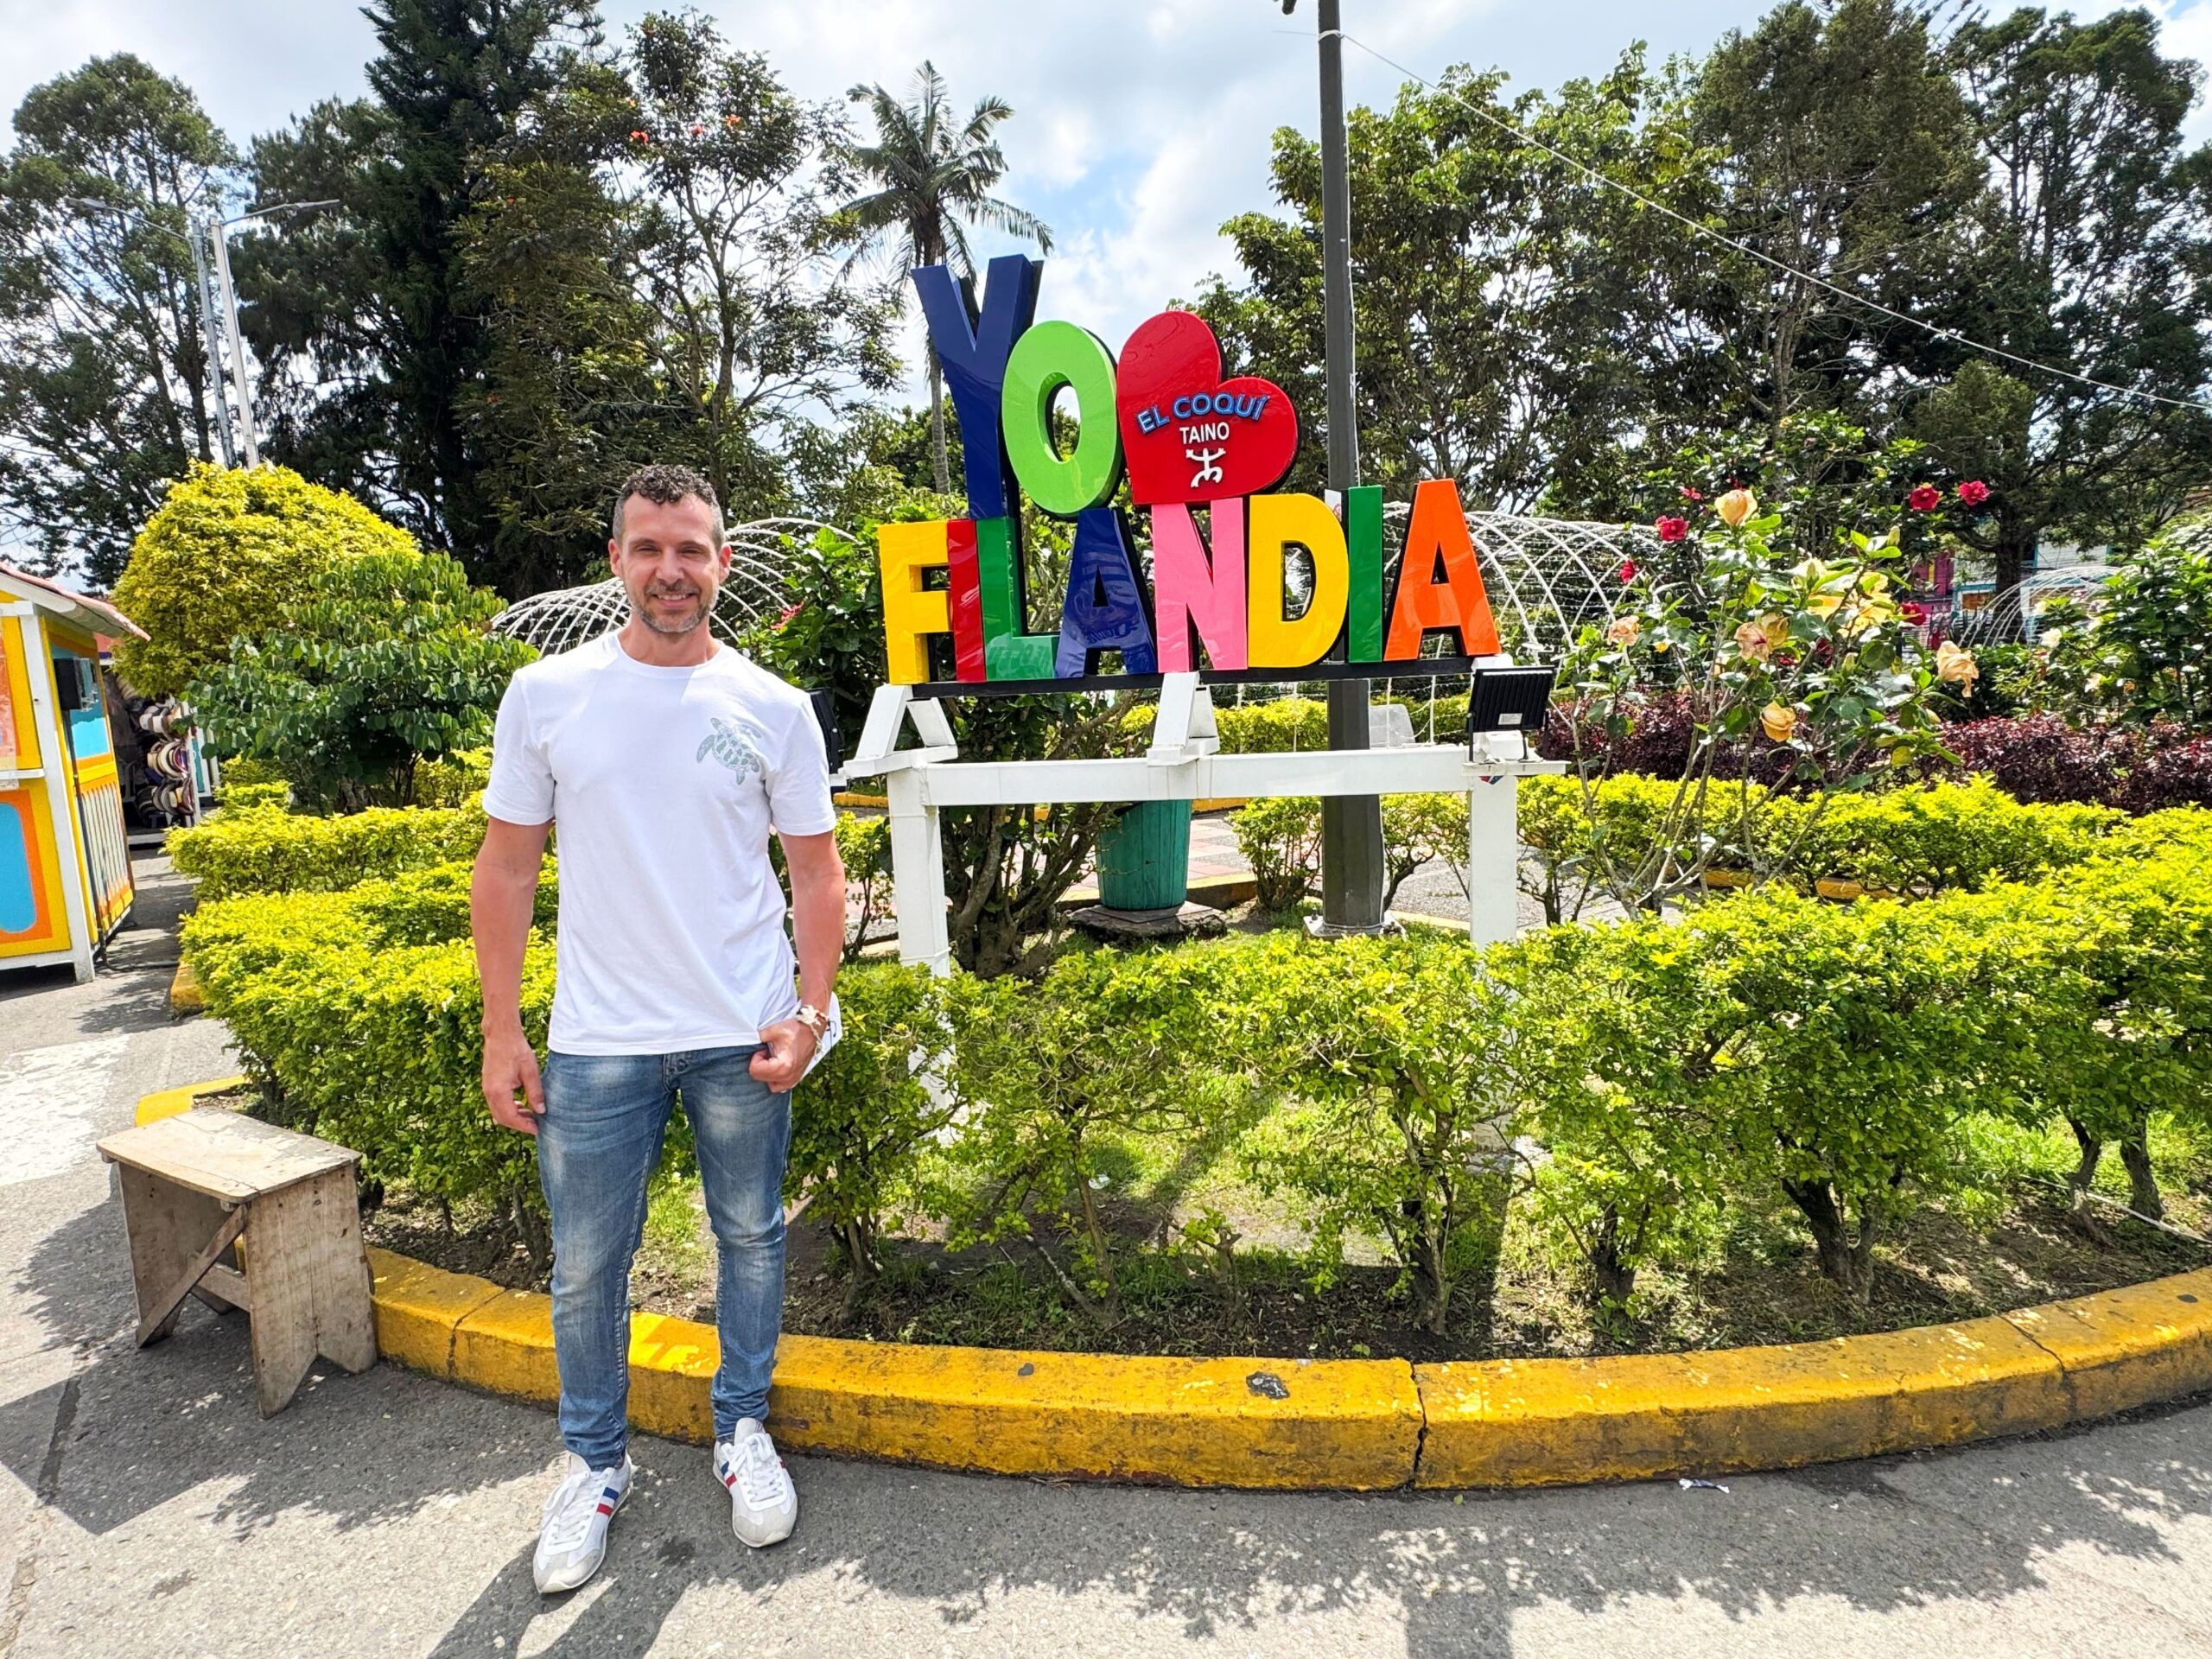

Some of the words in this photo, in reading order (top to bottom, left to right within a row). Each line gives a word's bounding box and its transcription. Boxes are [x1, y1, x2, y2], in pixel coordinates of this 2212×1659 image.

[912, 254, 1120, 518] YO
[1136, 404, 1170, 435] EL
[1179, 422, 1230, 444] TAINO
[877, 479, 1502, 685] FILANDIA
